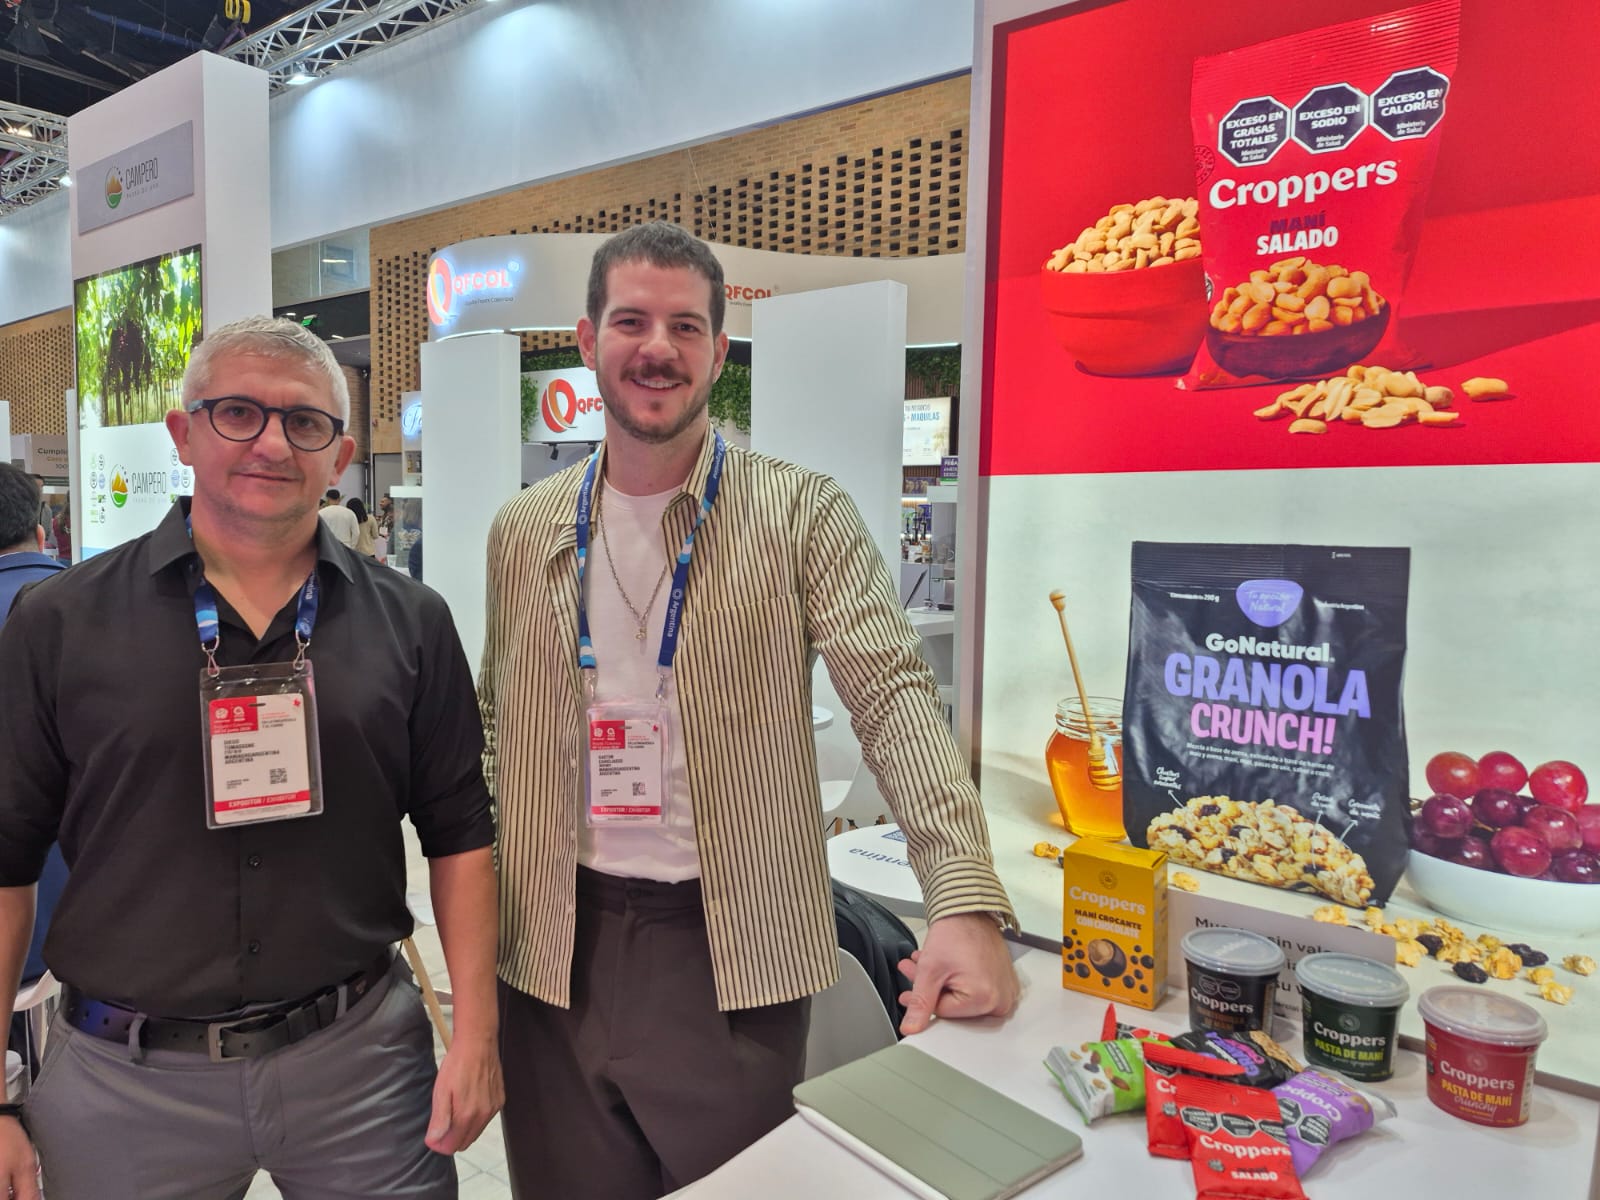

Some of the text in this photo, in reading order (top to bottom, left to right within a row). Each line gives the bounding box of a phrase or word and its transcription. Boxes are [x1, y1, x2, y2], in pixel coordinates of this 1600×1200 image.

[1378, 88, 1443, 107] EXCESO EN
[1381, 99, 1439, 117] CALORÍAS
[1226, 110, 1284, 129] EXCESO EN
[1299, 104, 1361, 121] EXCESO EN
[1311, 116, 1347, 129] SODIO
[1230, 133, 1278, 149] TOTALES
[1233, 123, 1275, 138] GRASAS
[126, 157, 158, 190] CAMPERO
[1209, 160, 1398, 209] Croppers
[1270, 211, 1326, 233] MANÍ
[1256, 226, 1338, 255] SALADO
[453, 269, 511, 295] QFCOL
[131, 471, 167, 495] CAMPERO
[1205, 632, 1335, 663] GoNatural
[1164, 652, 1371, 719] GRANOLA
[1190, 702, 1336, 755] CRUNCH!
[1069, 885, 1146, 916] Croppers
[1098, 913, 1142, 930] CROCANTE
[1191, 987, 1254, 1014] Croppers
[1314, 1021, 1387, 1047] Croppers
[1315, 1038, 1342, 1056] PASTA
[1343, 1048, 1357, 1059] DE
[1440, 1060, 1515, 1090] Croppers
[1441, 1079, 1513, 1106] PASTA DE MANÍ
[1200, 1135, 1292, 1158] Croppers
[1231, 1171, 1278, 1181] SALADO
